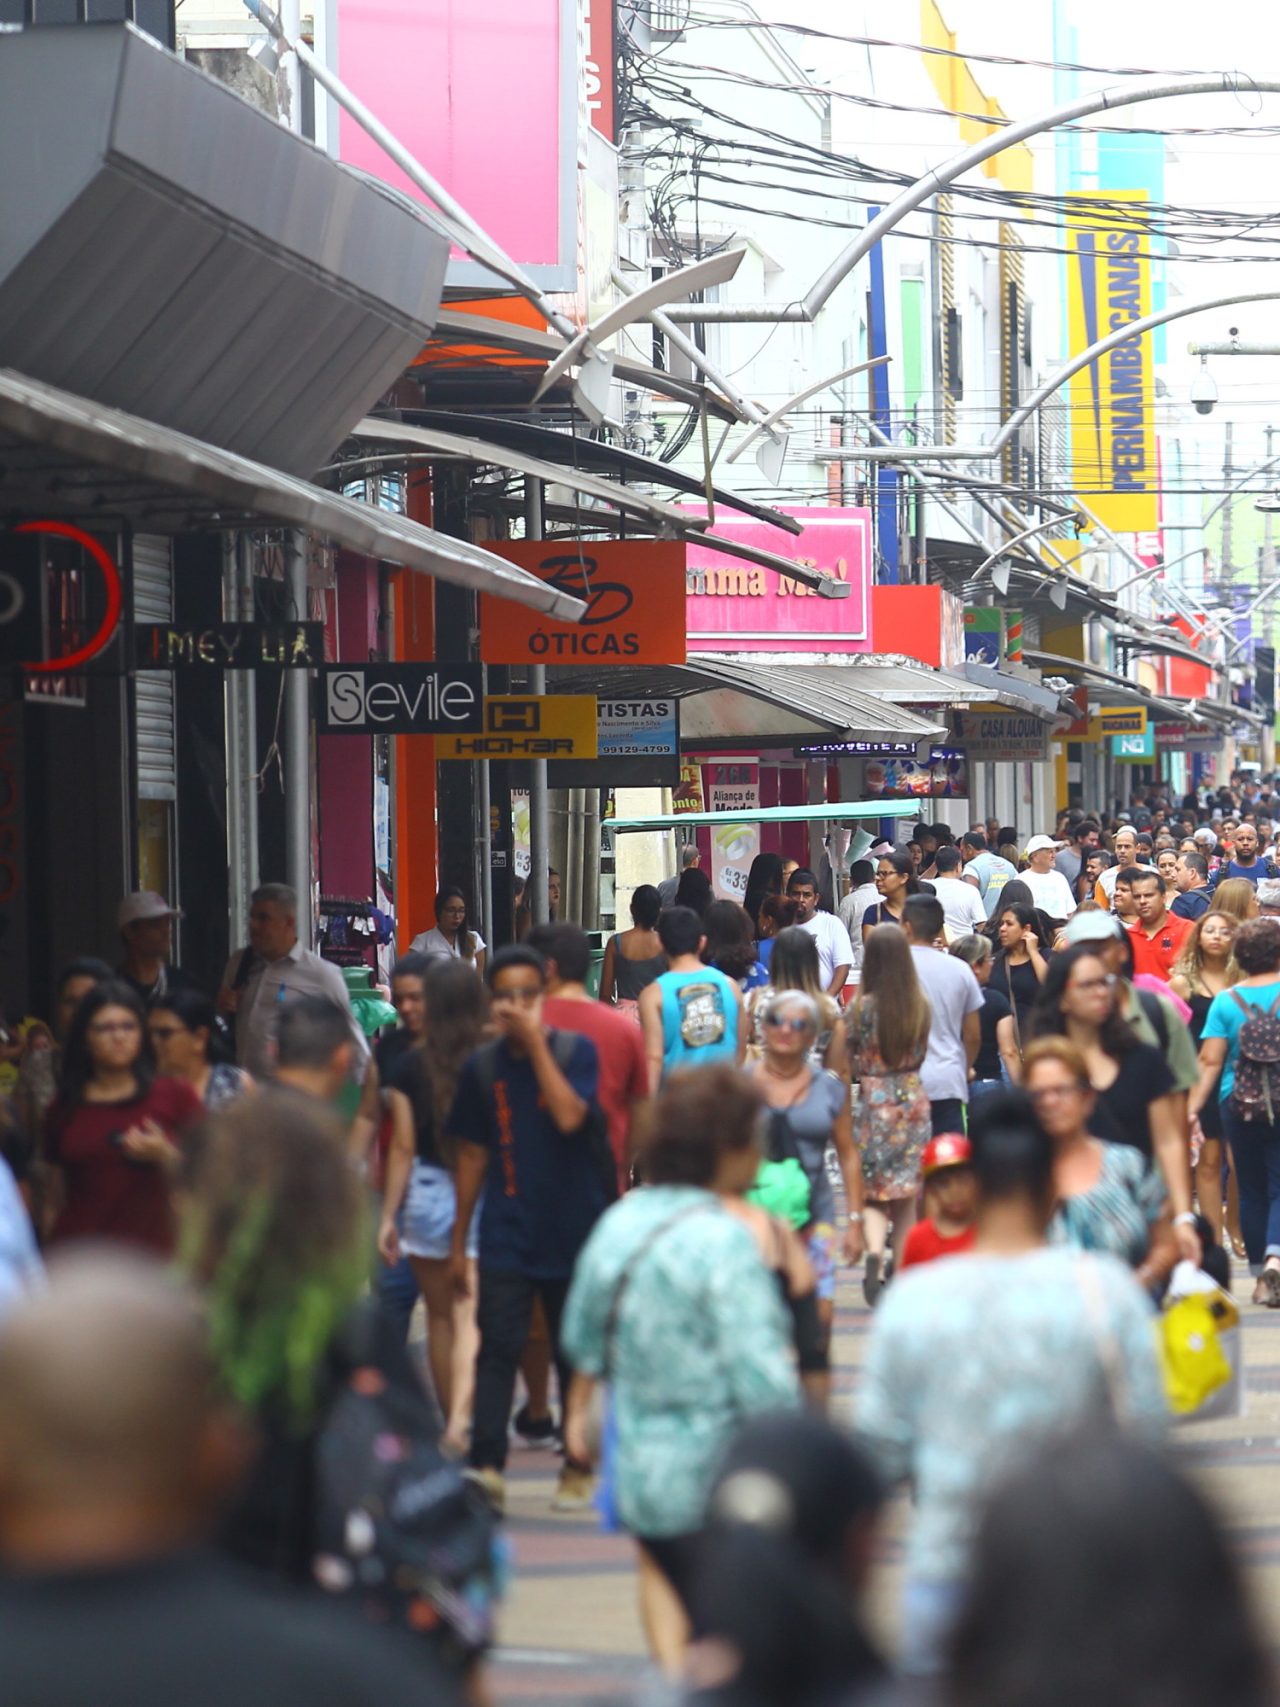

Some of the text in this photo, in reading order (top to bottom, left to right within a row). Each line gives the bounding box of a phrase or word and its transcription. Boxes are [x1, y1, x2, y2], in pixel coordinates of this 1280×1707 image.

[528, 628, 640, 655] ÓTICAS
[330, 672, 475, 723] Sevile
[603, 745, 670, 753] 99129-4799
[713, 790, 755, 803] Aliança de
